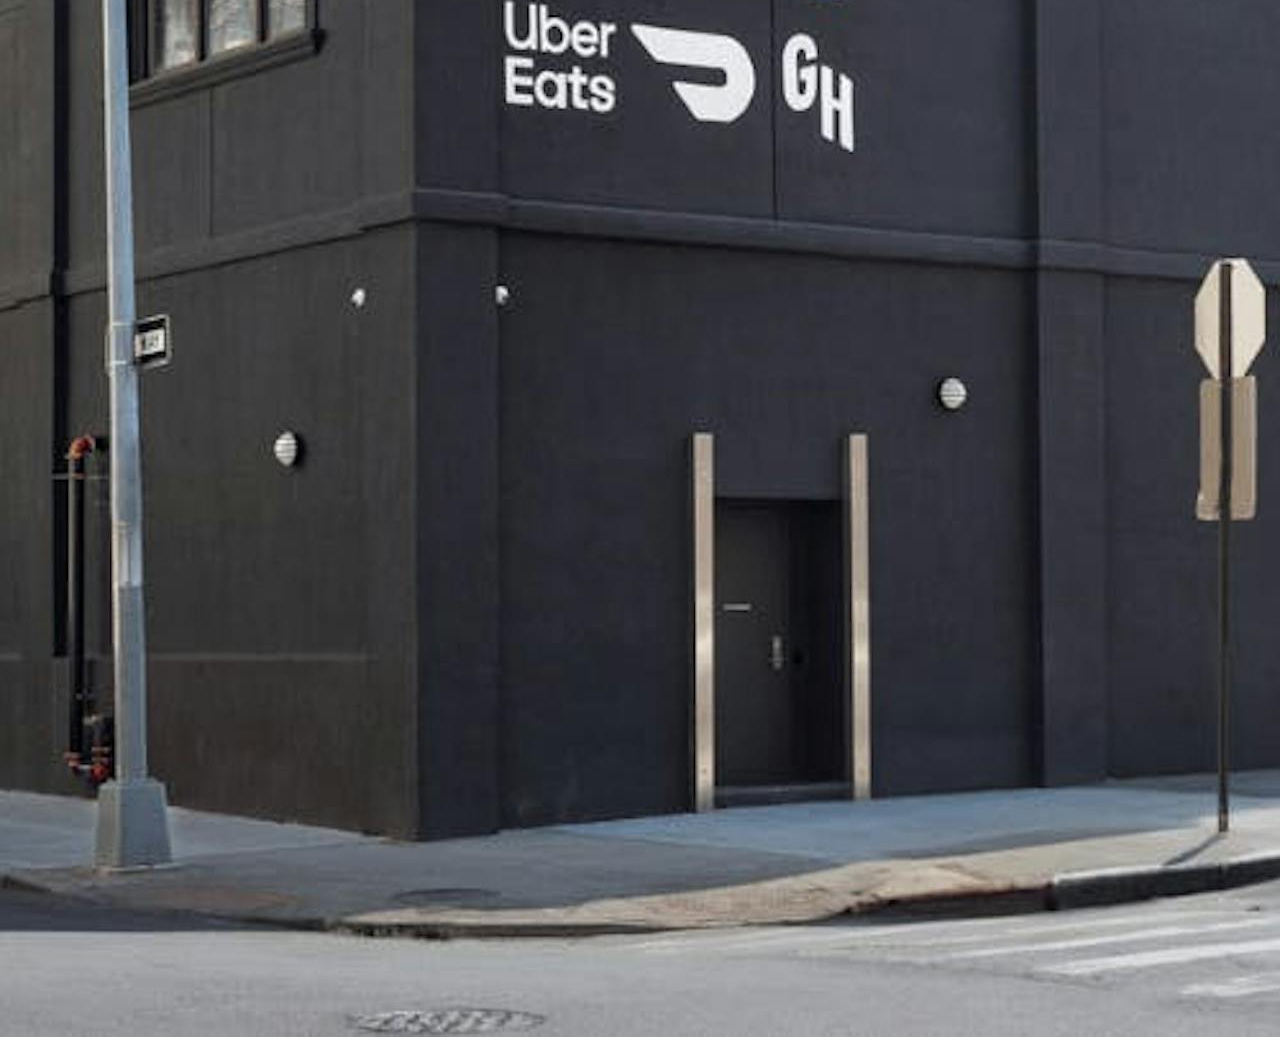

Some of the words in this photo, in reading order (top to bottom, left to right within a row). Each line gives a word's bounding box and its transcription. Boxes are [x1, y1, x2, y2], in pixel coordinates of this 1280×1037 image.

[504, 0, 617, 58] Uber
[505, 55, 616, 113] Eats
[782, 33, 854, 153] GH
